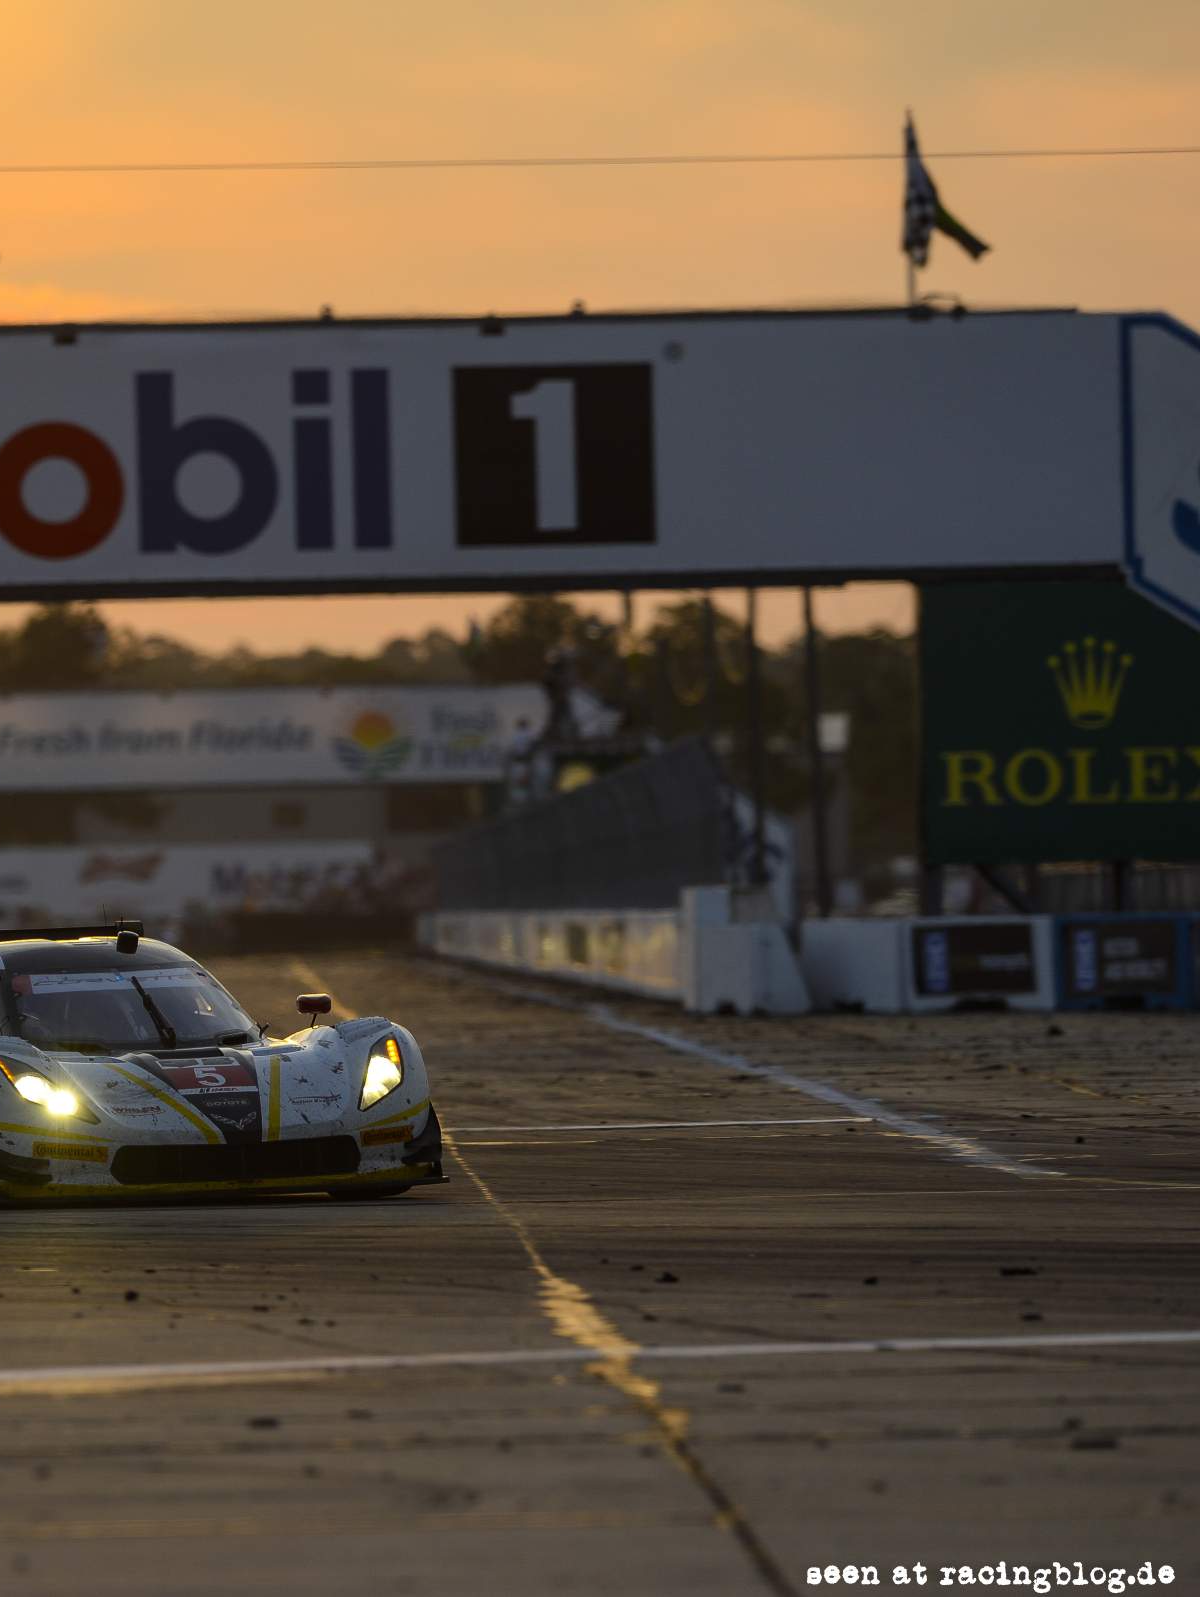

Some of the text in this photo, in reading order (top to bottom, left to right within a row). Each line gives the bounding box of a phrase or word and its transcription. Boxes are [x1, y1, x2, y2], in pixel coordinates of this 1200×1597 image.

[510, 379, 579, 533] 1
[941, 748, 1200, 806] ROLE
[194, 1067, 226, 1087] 5
